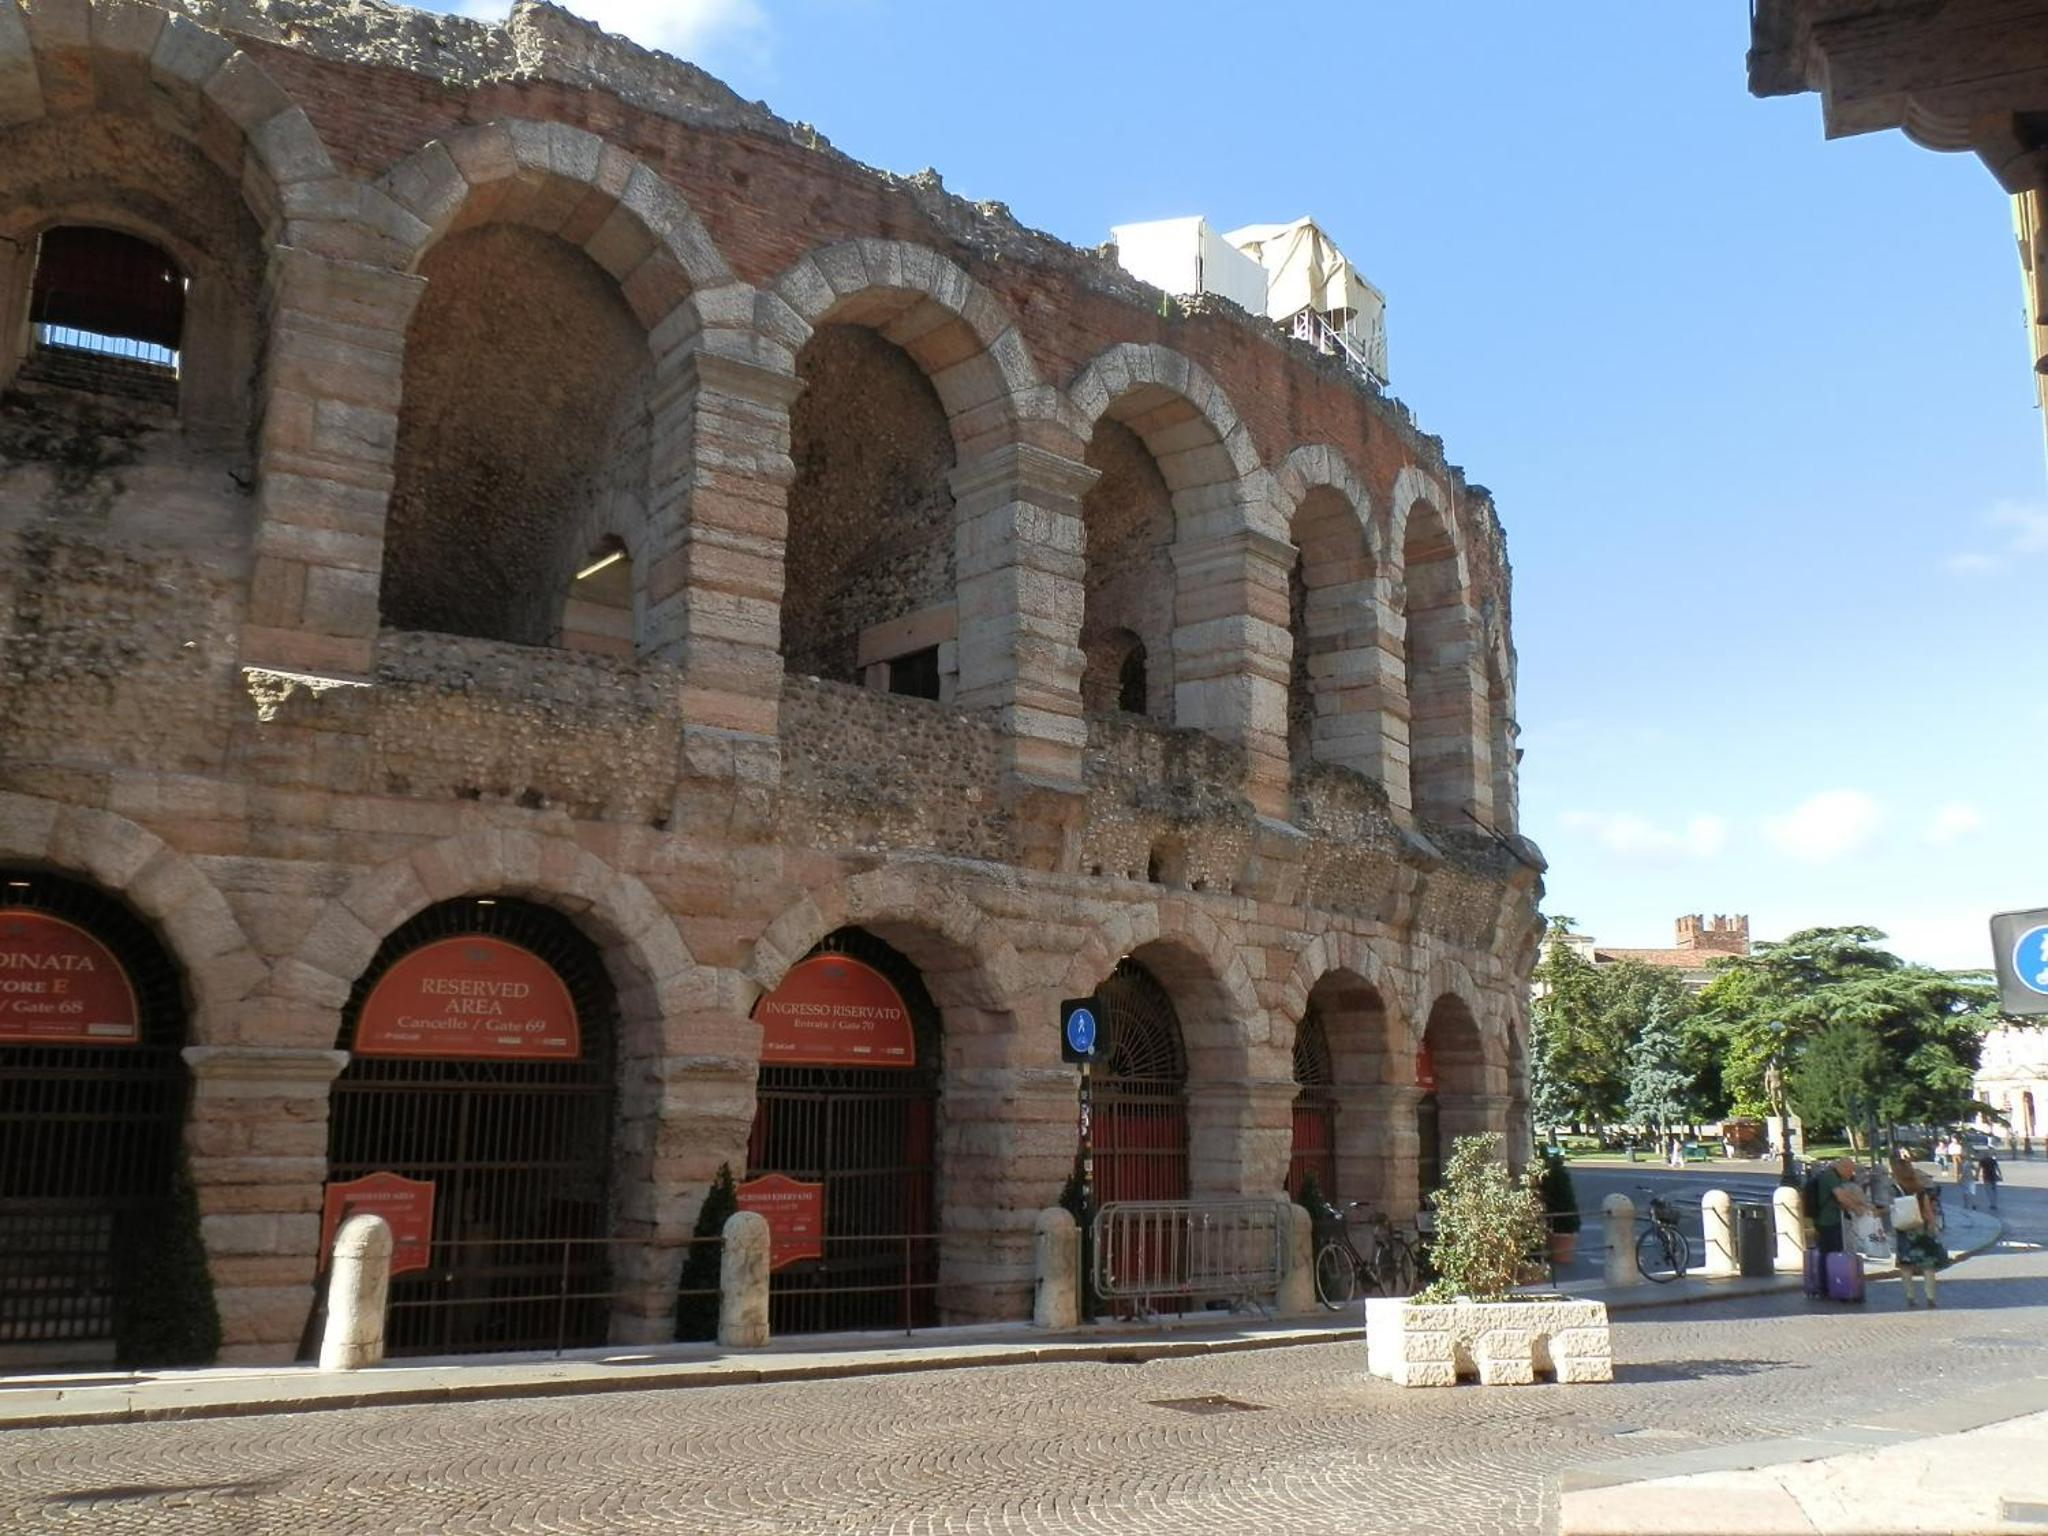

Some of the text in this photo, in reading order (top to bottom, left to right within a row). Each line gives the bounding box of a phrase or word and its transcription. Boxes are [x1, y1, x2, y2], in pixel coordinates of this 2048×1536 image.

[0, 978, 69, 993] ORE E
[421, 977, 530, 999] RESERVED
[12, 999, 55, 1013] Gate
[58, 998, 84, 1014] 68
[444, 998, 503, 1015] AREA
[765, 1001, 901, 1020] INGRESSO RISERVATO
[397, 1016, 467, 1031] Cancello
[485, 1018, 521, 1032] Gate
[525, 1018, 547, 1033] 69
